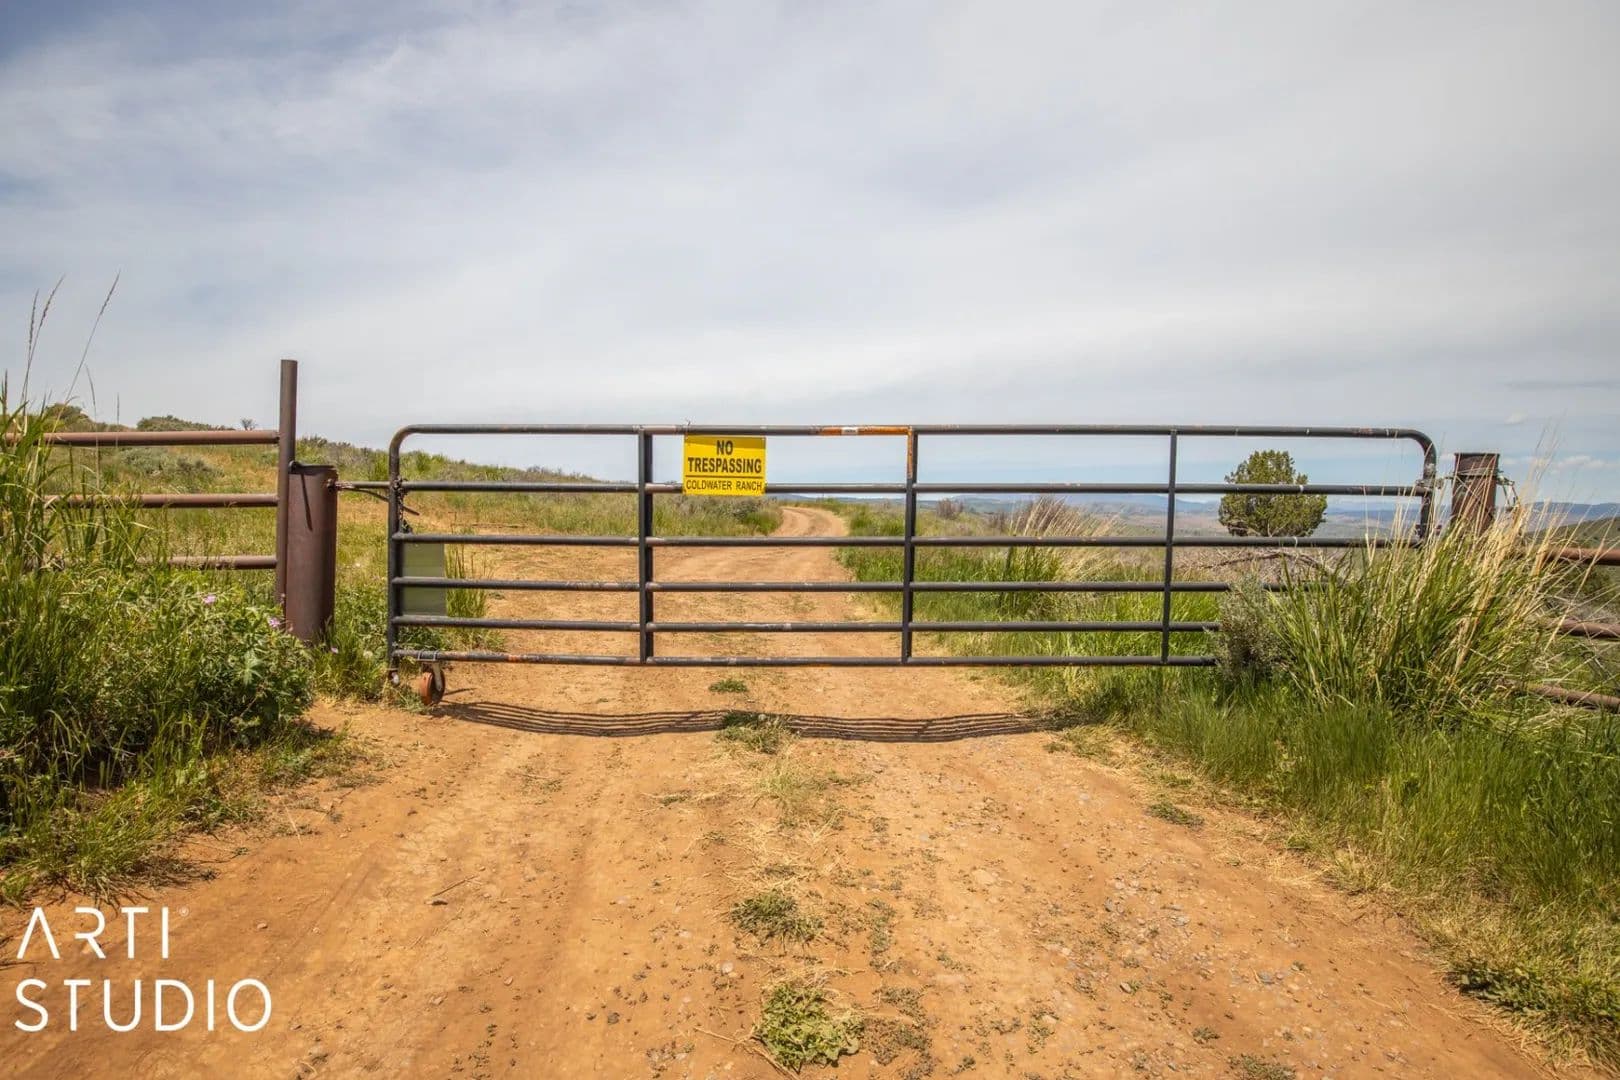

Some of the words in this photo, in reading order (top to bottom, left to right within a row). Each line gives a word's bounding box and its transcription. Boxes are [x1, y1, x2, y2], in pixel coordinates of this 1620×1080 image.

[716, 440, 734, 455] NO
[687, 457, 762, 473] TRESPASSING
[686, 480, 732, 490] COLDWATER
[736, 480, 762, 491] RANCH
